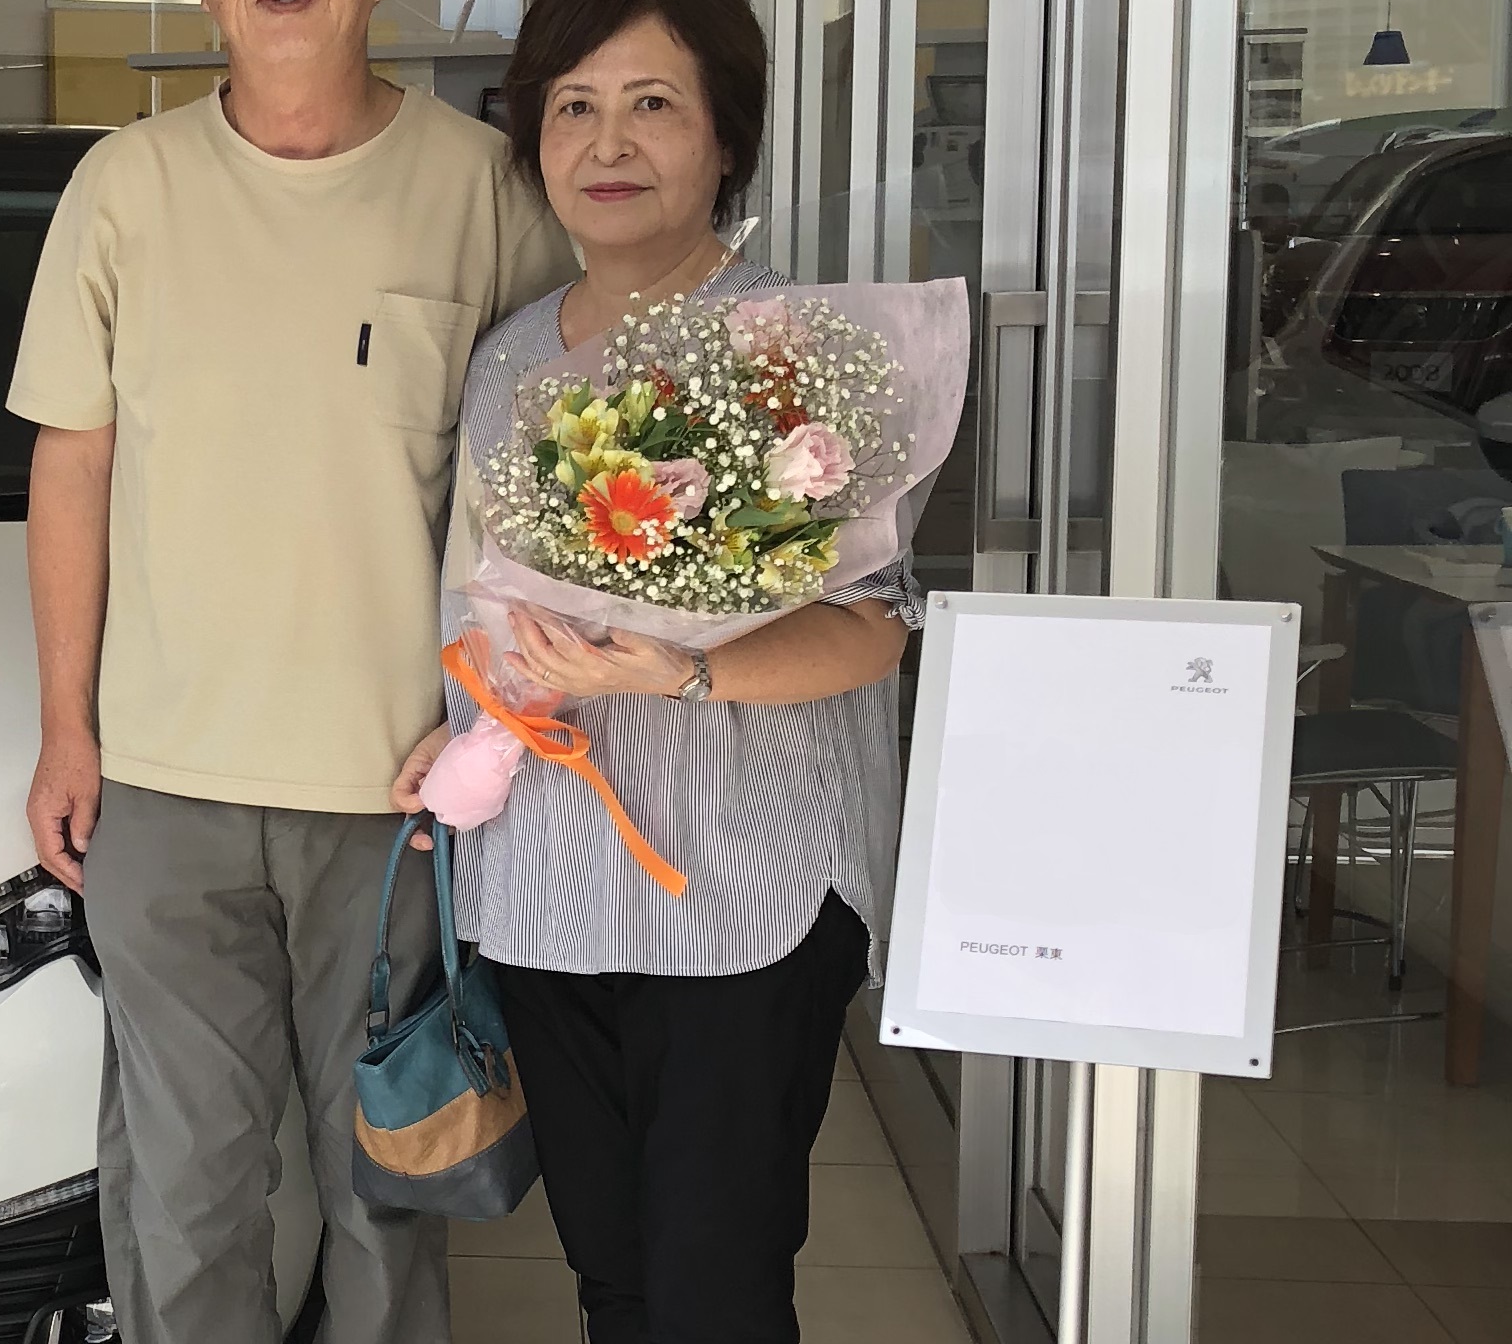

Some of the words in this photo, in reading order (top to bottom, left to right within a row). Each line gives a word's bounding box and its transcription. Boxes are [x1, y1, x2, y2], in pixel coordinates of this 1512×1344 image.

[1171, 685, 1229, 694] PEUGEOT
[960, 941, 1028, 956] PEUGEOT
[1035, 946, 1063, 960] 栗東
